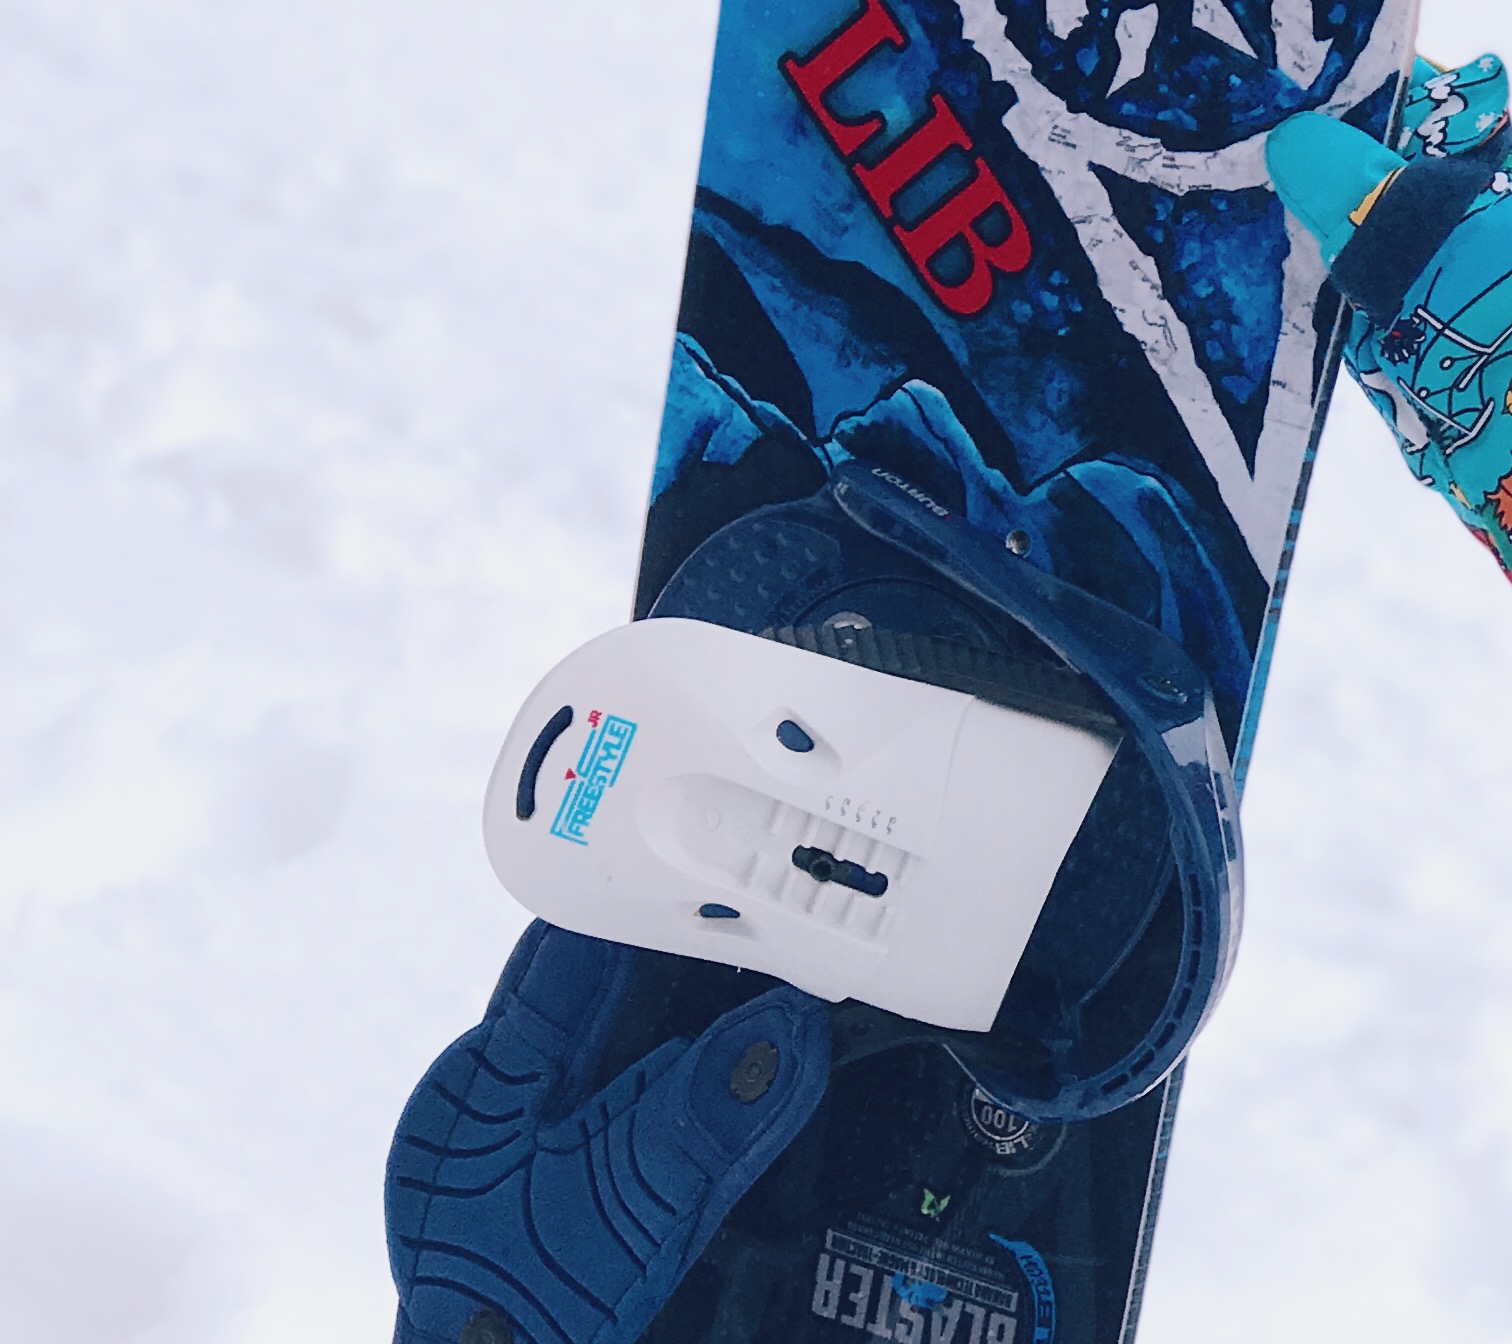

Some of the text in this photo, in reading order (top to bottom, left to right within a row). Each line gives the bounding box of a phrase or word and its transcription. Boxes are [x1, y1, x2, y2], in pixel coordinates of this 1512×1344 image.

[588, 709, 602, 728] JR
[567, 723, 629, 838] FREESTYLE
[981, 1105, 1017, 1133] 100
